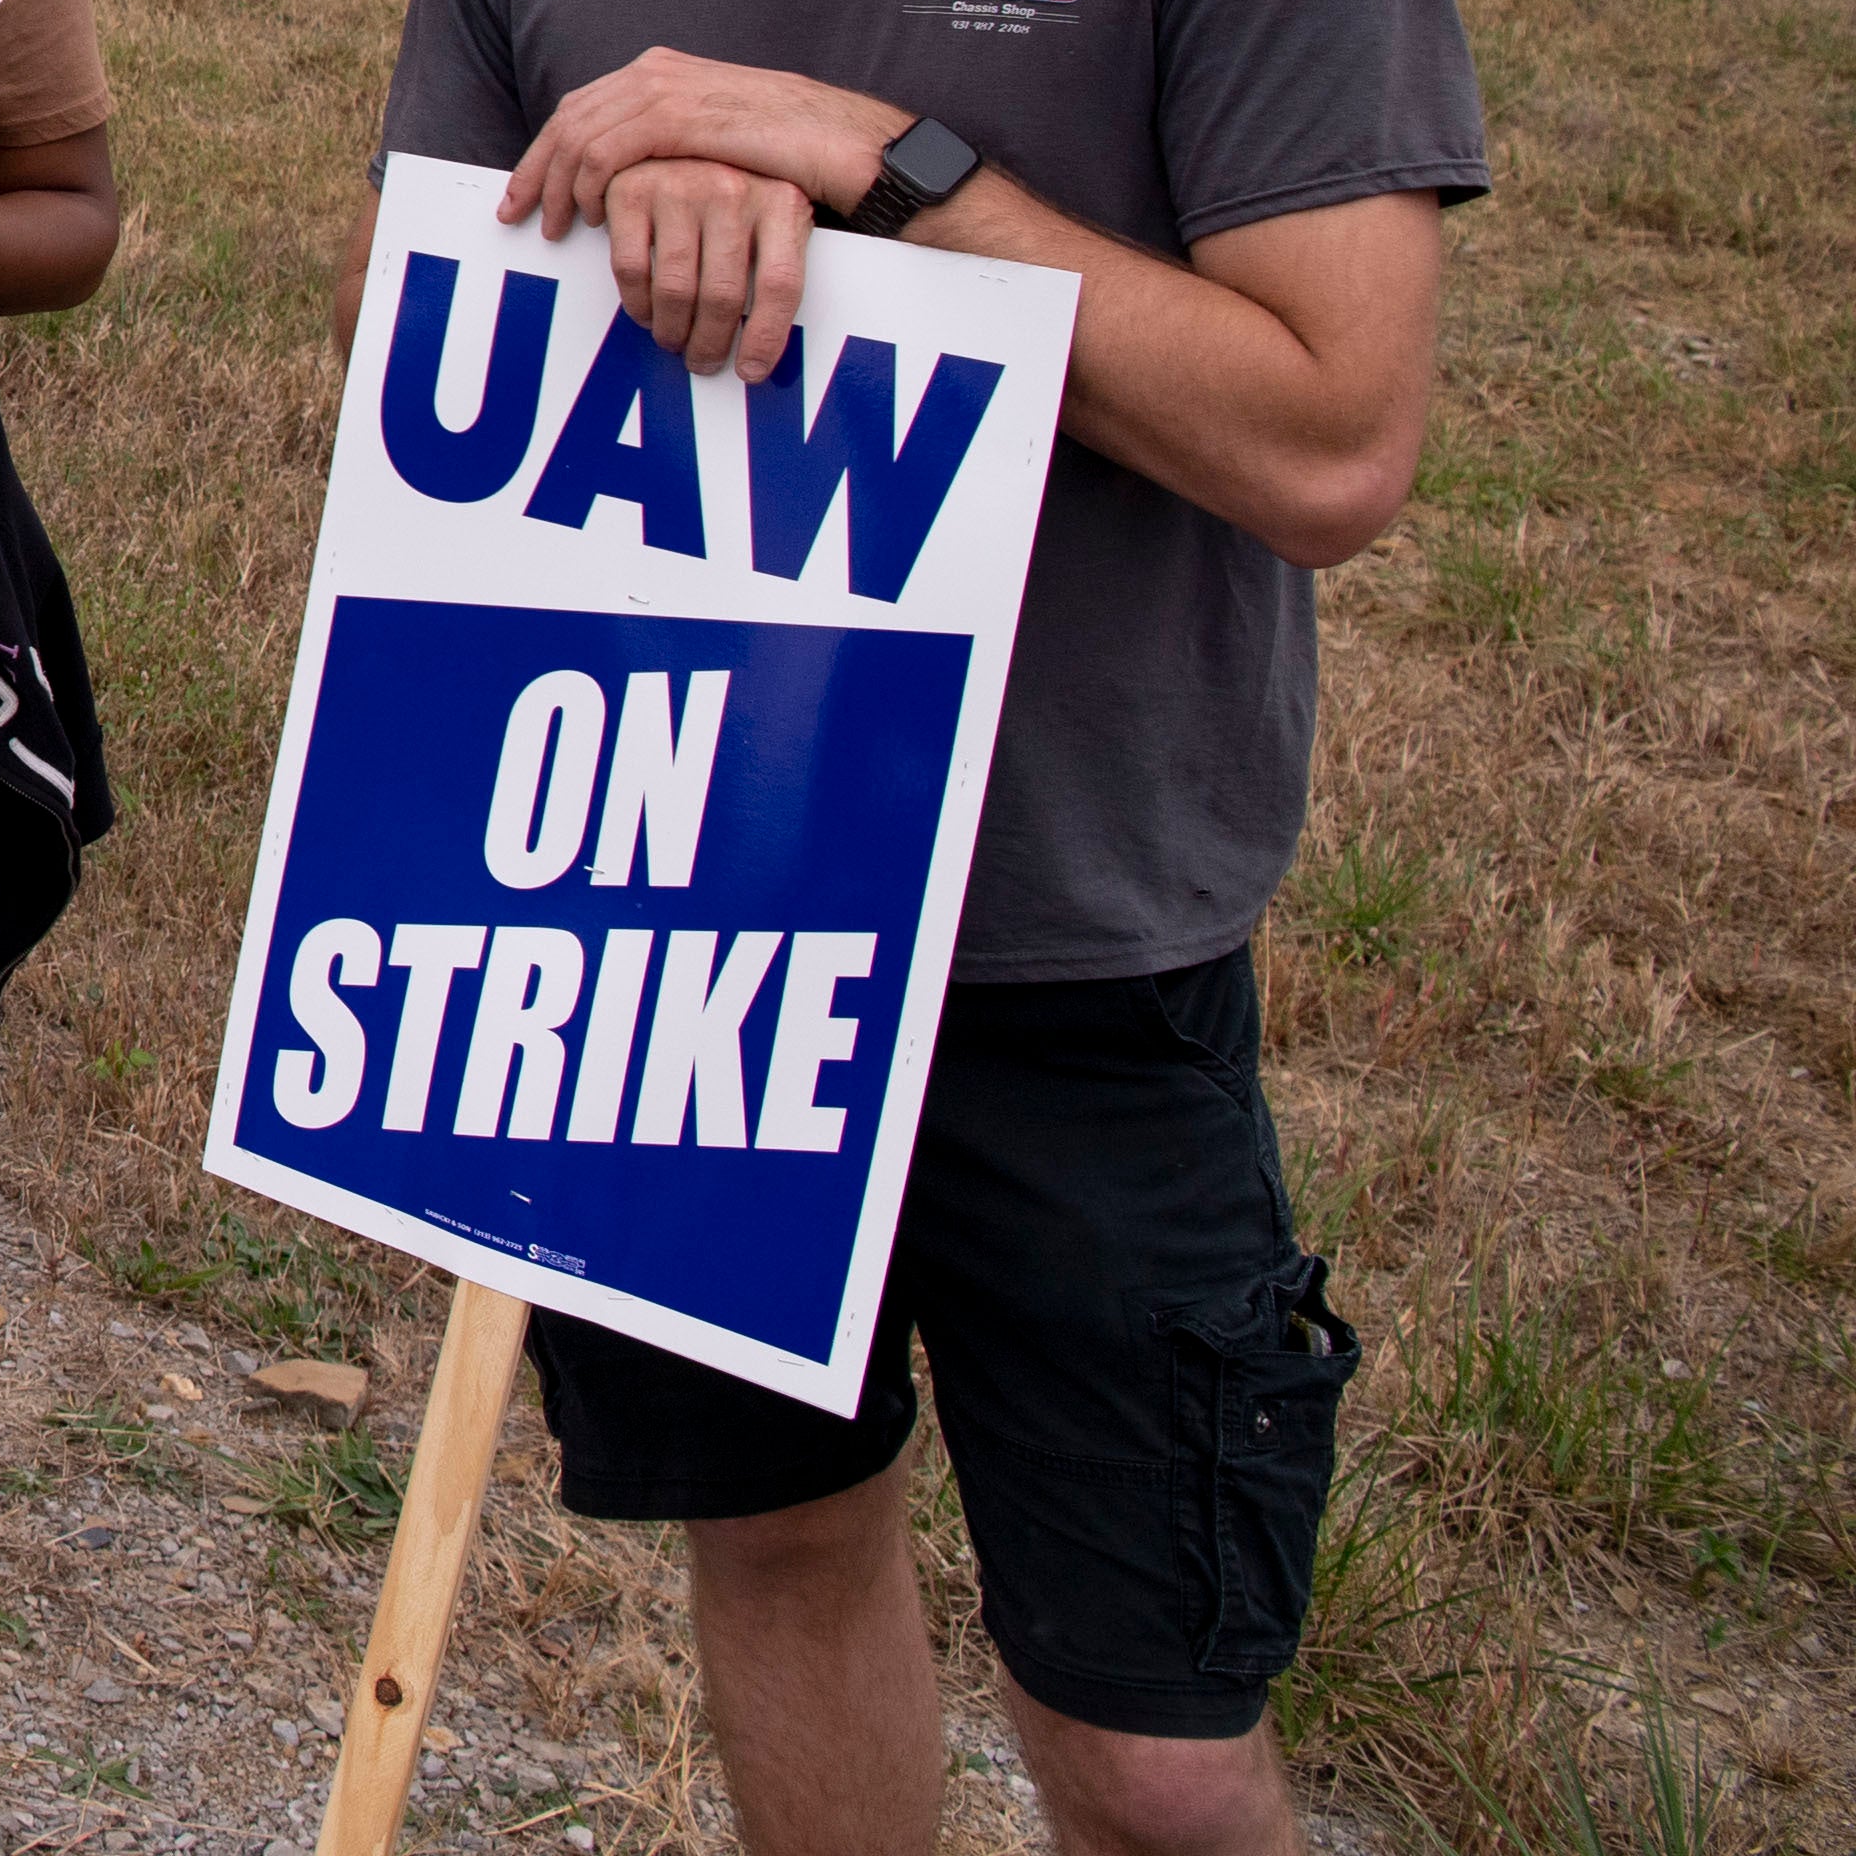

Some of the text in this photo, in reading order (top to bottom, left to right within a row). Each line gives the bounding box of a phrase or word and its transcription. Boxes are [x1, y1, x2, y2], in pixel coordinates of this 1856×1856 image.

[952, 0, 1036, 19] Chassis Shop
[379, 250, 1006, 605] UAW
[483, 668, 731, 891] ON
[271, 918, 879, 1153] STRIKE
